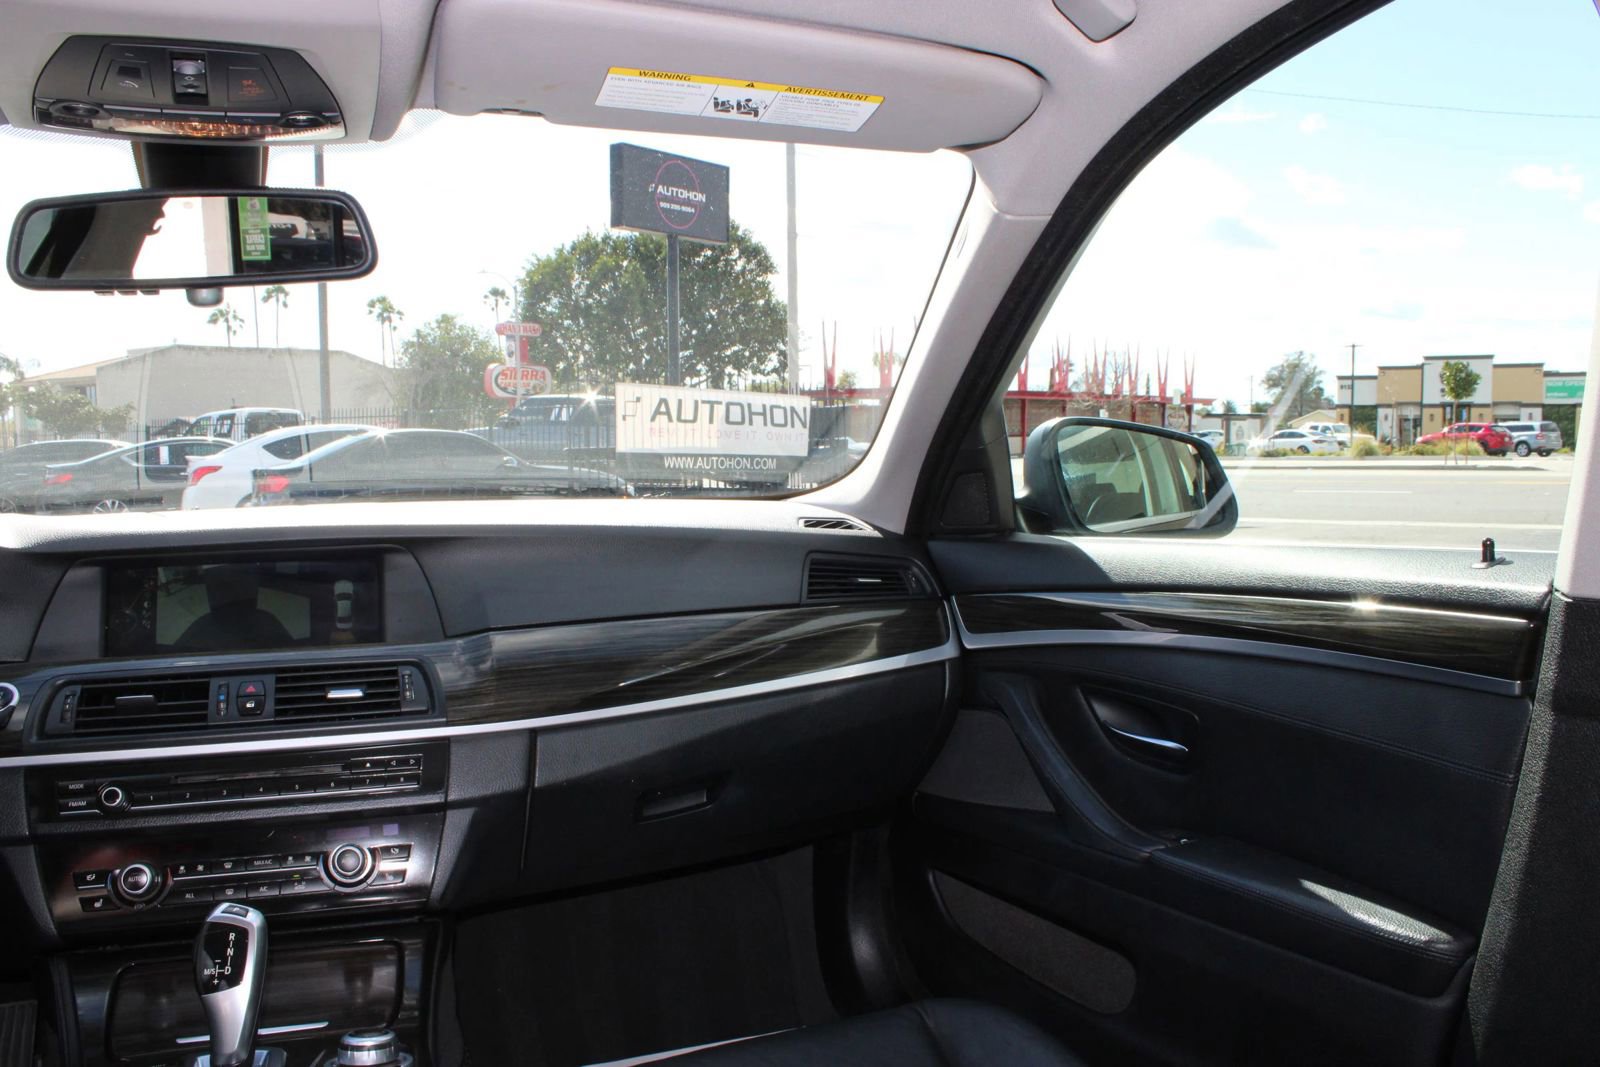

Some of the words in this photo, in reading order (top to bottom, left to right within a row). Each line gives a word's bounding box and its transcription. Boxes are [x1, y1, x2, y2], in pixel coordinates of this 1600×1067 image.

[638, 70, 691, 82] WARNING
[784, 86, 870, 102] AVERTISSEMENT
[657, 185, 706, 202] AUTOHON
[650, 397, 808, 429] AUTOHON
[664, 456, 776, 470] WWW.AUTOHON.COM
[229, 932, 236, 941] R
[227, 947, 234, 956] N
[224, 966, 231, 975] D
